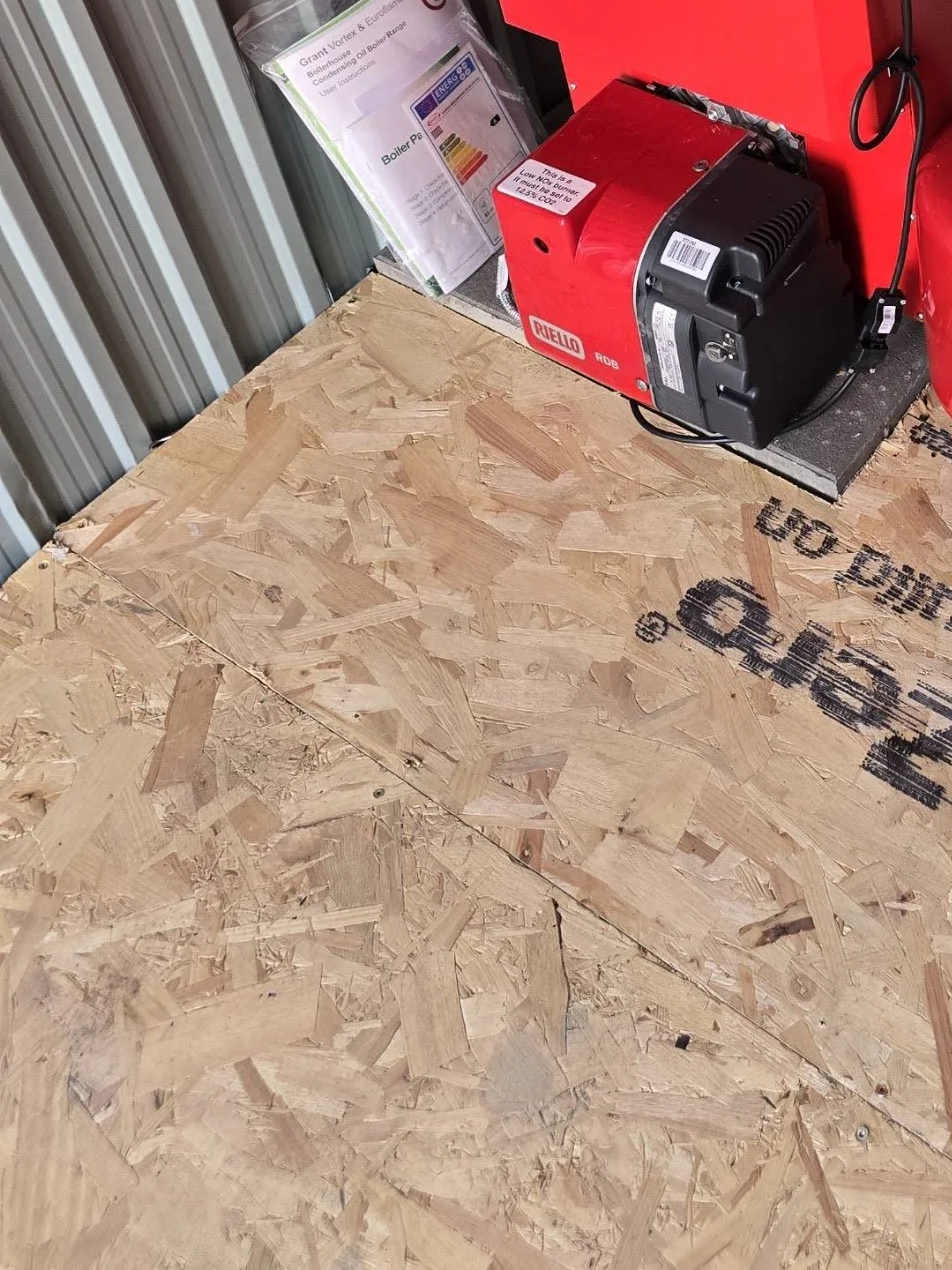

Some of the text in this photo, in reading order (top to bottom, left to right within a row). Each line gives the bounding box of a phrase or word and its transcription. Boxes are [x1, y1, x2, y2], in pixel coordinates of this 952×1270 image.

[299, 47, 329, 67] Grant
[328, 29, 357, 50] Vortex
[312, 57, 357, 87] Condensing
[366, 35, 387, 52] Boiler
[385, 20, 408, 39] Range
[306, 49, 352, 79] Boilerhouse
[381, 141, 411, 165] Boiler
[519, 169, 536, 179] Low
[535, 175, 552, 186] NOx
[541, 168, 558, 179] This
[520, 179, 540, 190] must
[539, 186, 550, 194] be
[549, 190, 564, 200] set
[563, 195, 572, 203] to
[538, 195, 557, 205] CO2
[533, 319, 580, 354] RIELLO
[594, 351, 620, 370] RDB
[754, 495, 839, 560] on
